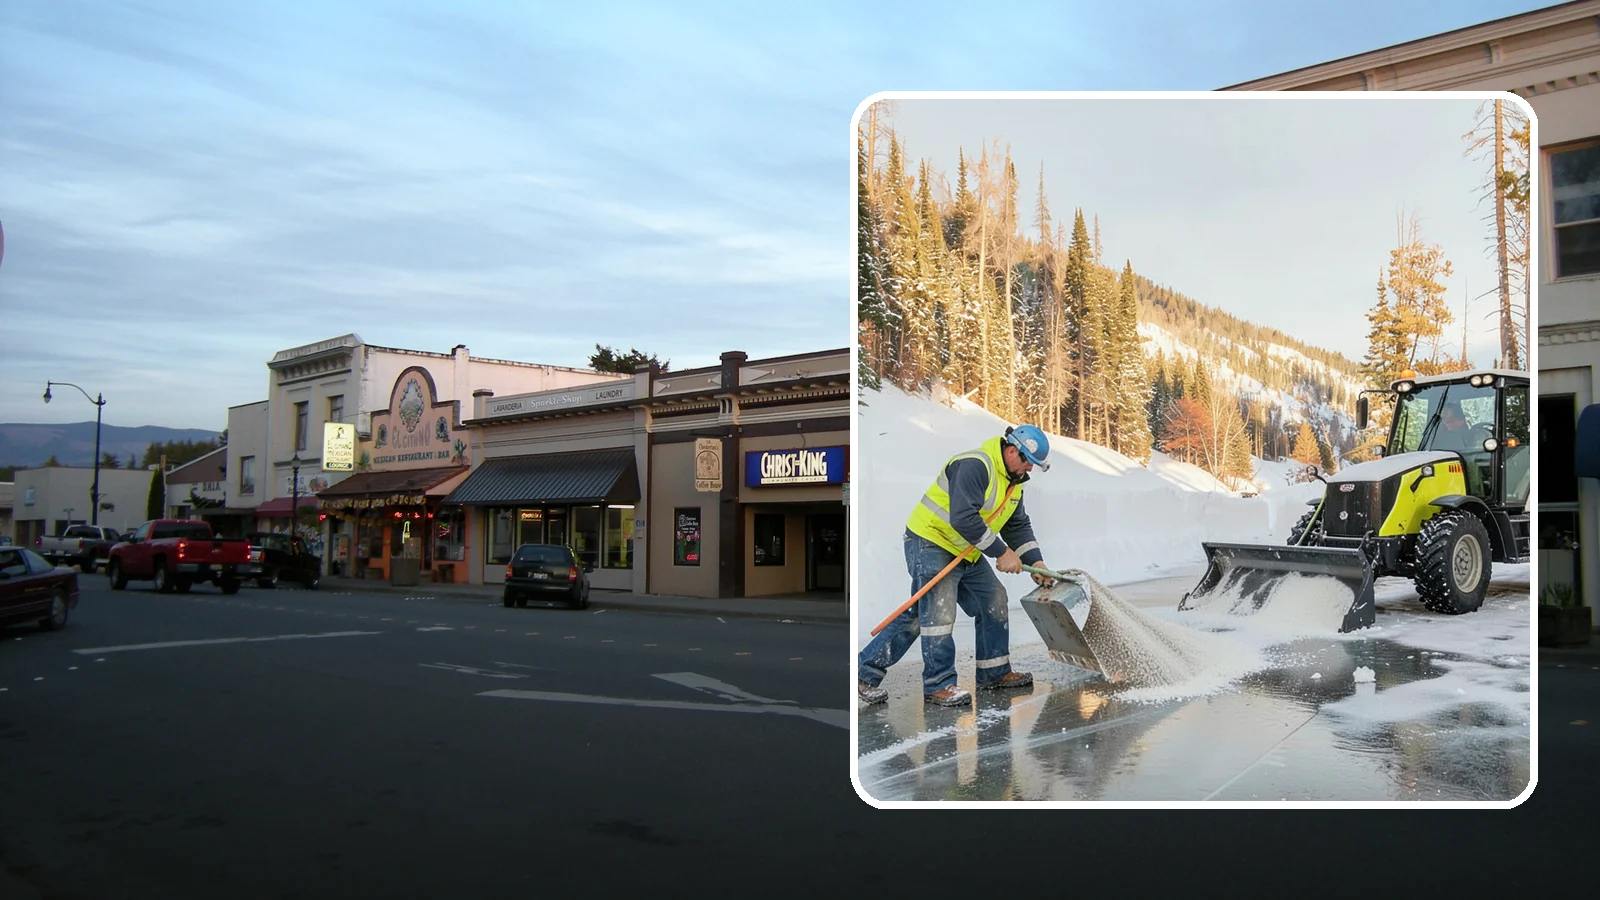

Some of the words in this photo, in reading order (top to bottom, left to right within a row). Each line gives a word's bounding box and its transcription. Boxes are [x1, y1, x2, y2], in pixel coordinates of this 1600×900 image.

[596, 389, 624, 399] LAUNDRY
[531, 396, 560, 409] Sparkle
[562, 394, 581, 404] Shop
[493, 402, 523, 413] LAVANDERIA
[374, 455, 396, 464] MEXICAN
[398, 451, 433, 462] RESTAURANT
[438, 450, 450, 459] BAR
[696, 480, 709, 489] Coffee
[710, 480, 721, 489] House
